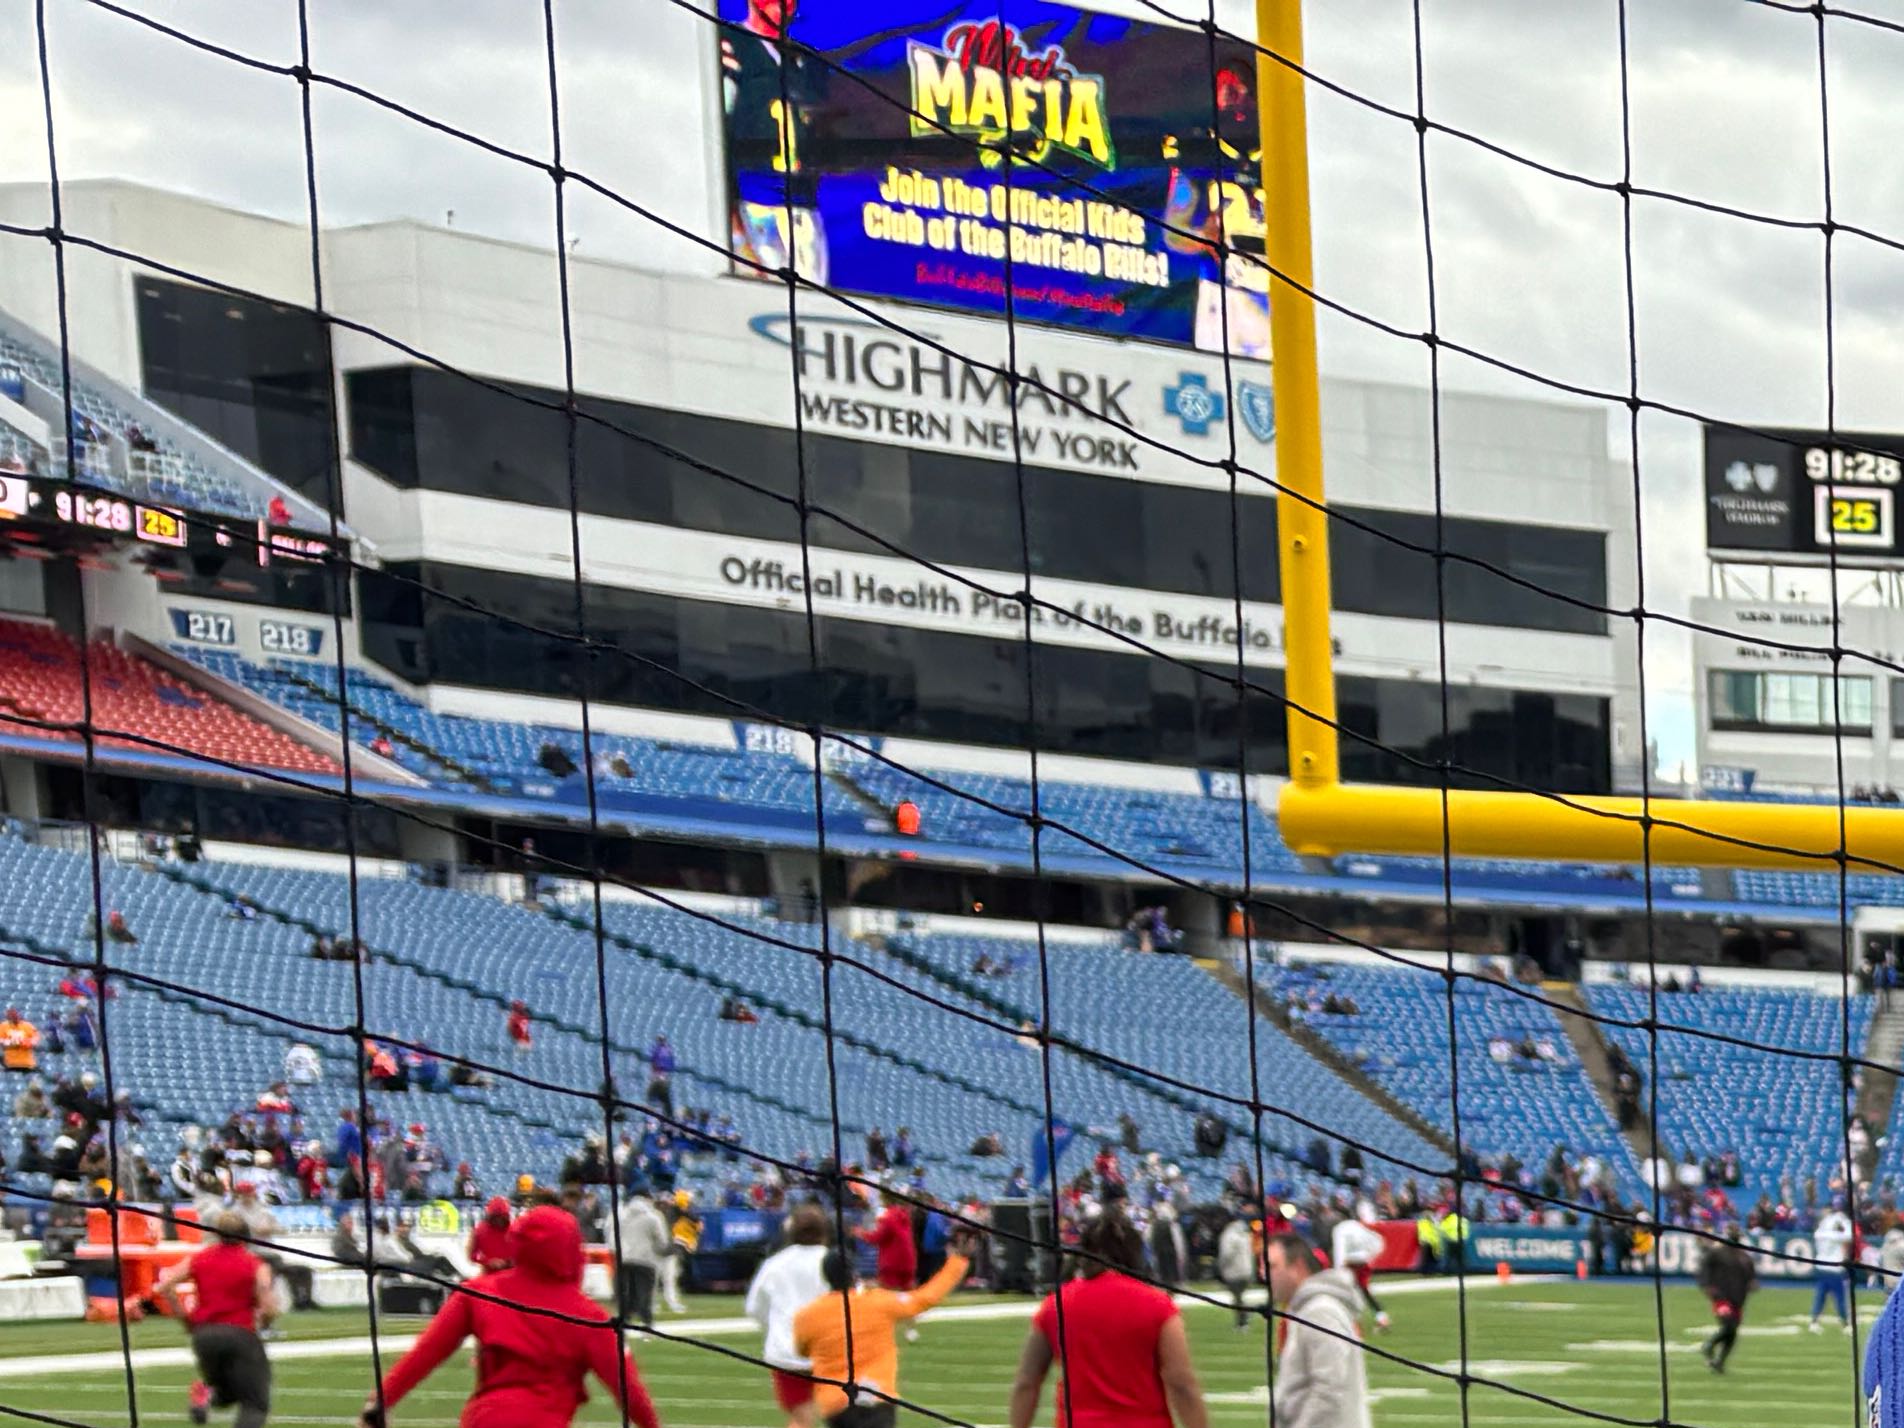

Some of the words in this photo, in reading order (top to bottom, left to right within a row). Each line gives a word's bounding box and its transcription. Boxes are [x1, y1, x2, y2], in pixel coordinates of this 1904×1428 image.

[914, 48, 1109, 162] MAFIA
[880, 165, 939, 209] Join
[942, 177, 988, 217] the
[990, 185, 1084, 234] Official
[1087, 201, 1146, 245] Kids
[863, 202, 924, 246] Club
[927, 216, 956, 251] of
[960, 220, 1005, 259] the
[1010, 226, 1100, 275] Buffalo
[798, 327, 1133, 427] HIGHMARK
[799, 393, 953, 444] WESTERN
[963, 421, 1041, 455] NEW
[1051, 433, 1139, 471] YORK
[1805, 447, 1902, 484] 91:28
[55, 492, 131, 532] 91:28
[143, 509, 177, 537] 25
[1832, 501, 1878, 532] 25
[719, 556, 842, 600] Official
[852, 573, 962, 612] Health
[971, 590, 1043, 624] Plan
[1055, 601, 1087, 630] of
[1094, 603, 1142, 638] the
[1154, 611, 1268, 651] Buffalo
[188, 614, 231, 642] 217
[262, 623, 309, 652] 218
[1475, 1238, 1575, 1261] WELCOME
